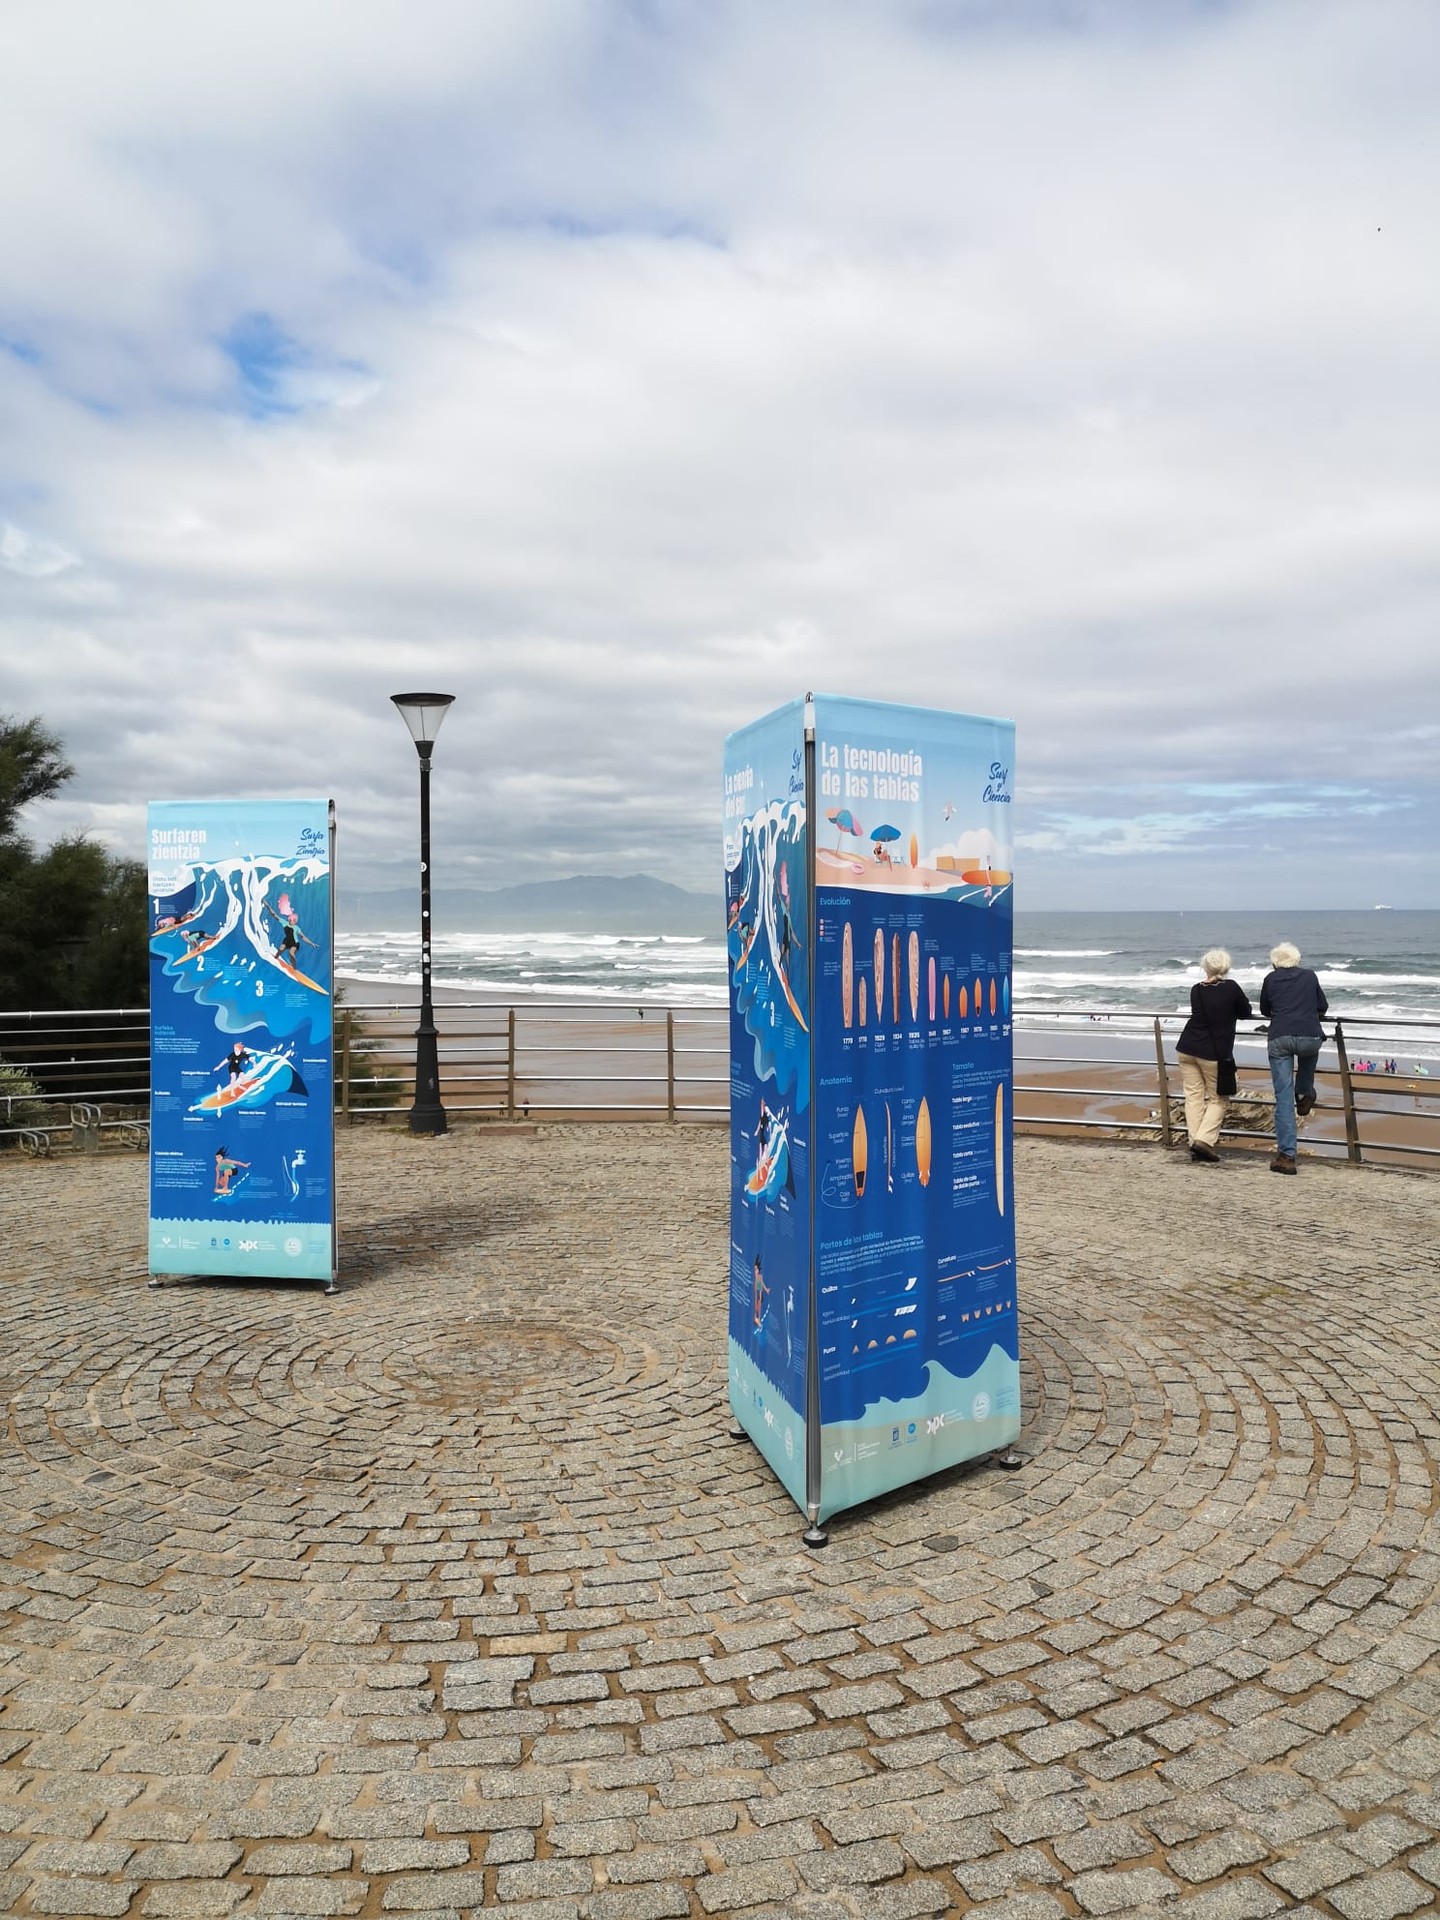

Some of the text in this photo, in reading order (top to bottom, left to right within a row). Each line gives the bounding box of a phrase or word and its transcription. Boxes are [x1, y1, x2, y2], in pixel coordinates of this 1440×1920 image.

[821, 742, 923, 776] La tecnología
[989, 762, 1008, 782] Surf
[822, 772, 920, 802] de las tablas
[982, 784, 1011, 804] Ciencia
[152, 828, 206, 845] Surfaren
[152, 844, 200, 860] zientzia
[153, 898, 160, 914] 1
[820, 896, 851, 906] Evolución
[197, 955, 205, 972] 2
[256, 980, 264, 997] 3
